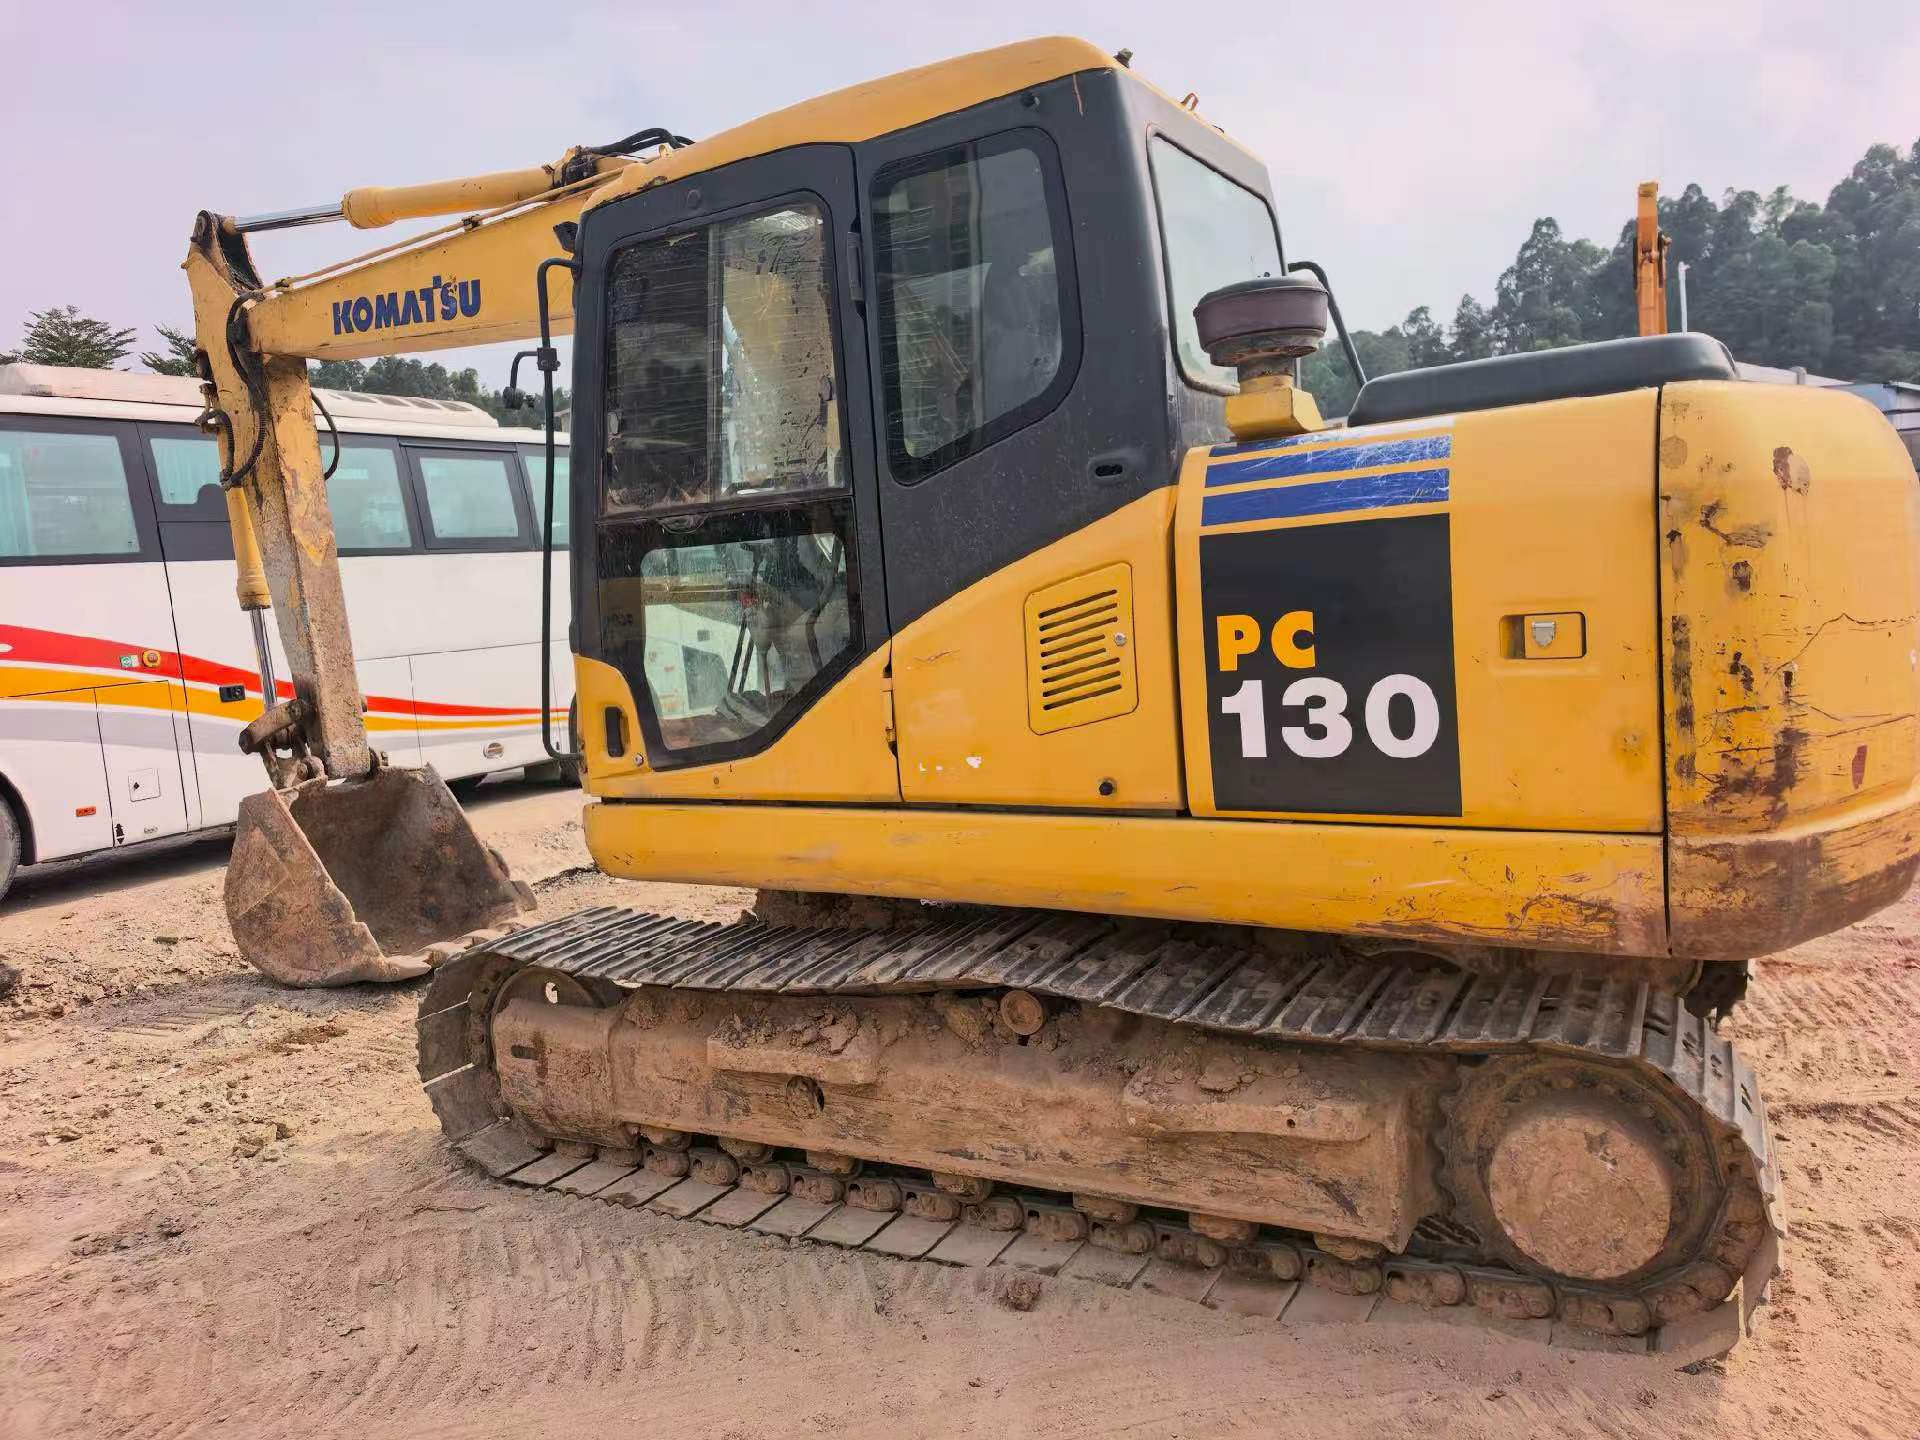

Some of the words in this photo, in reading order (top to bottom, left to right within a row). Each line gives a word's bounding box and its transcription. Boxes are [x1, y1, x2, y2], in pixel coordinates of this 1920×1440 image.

[332, 275, 481, 336] KOMATSU
[1216, 610, 1316, 672] PC
[1221, 673, 1440, 759] 130
